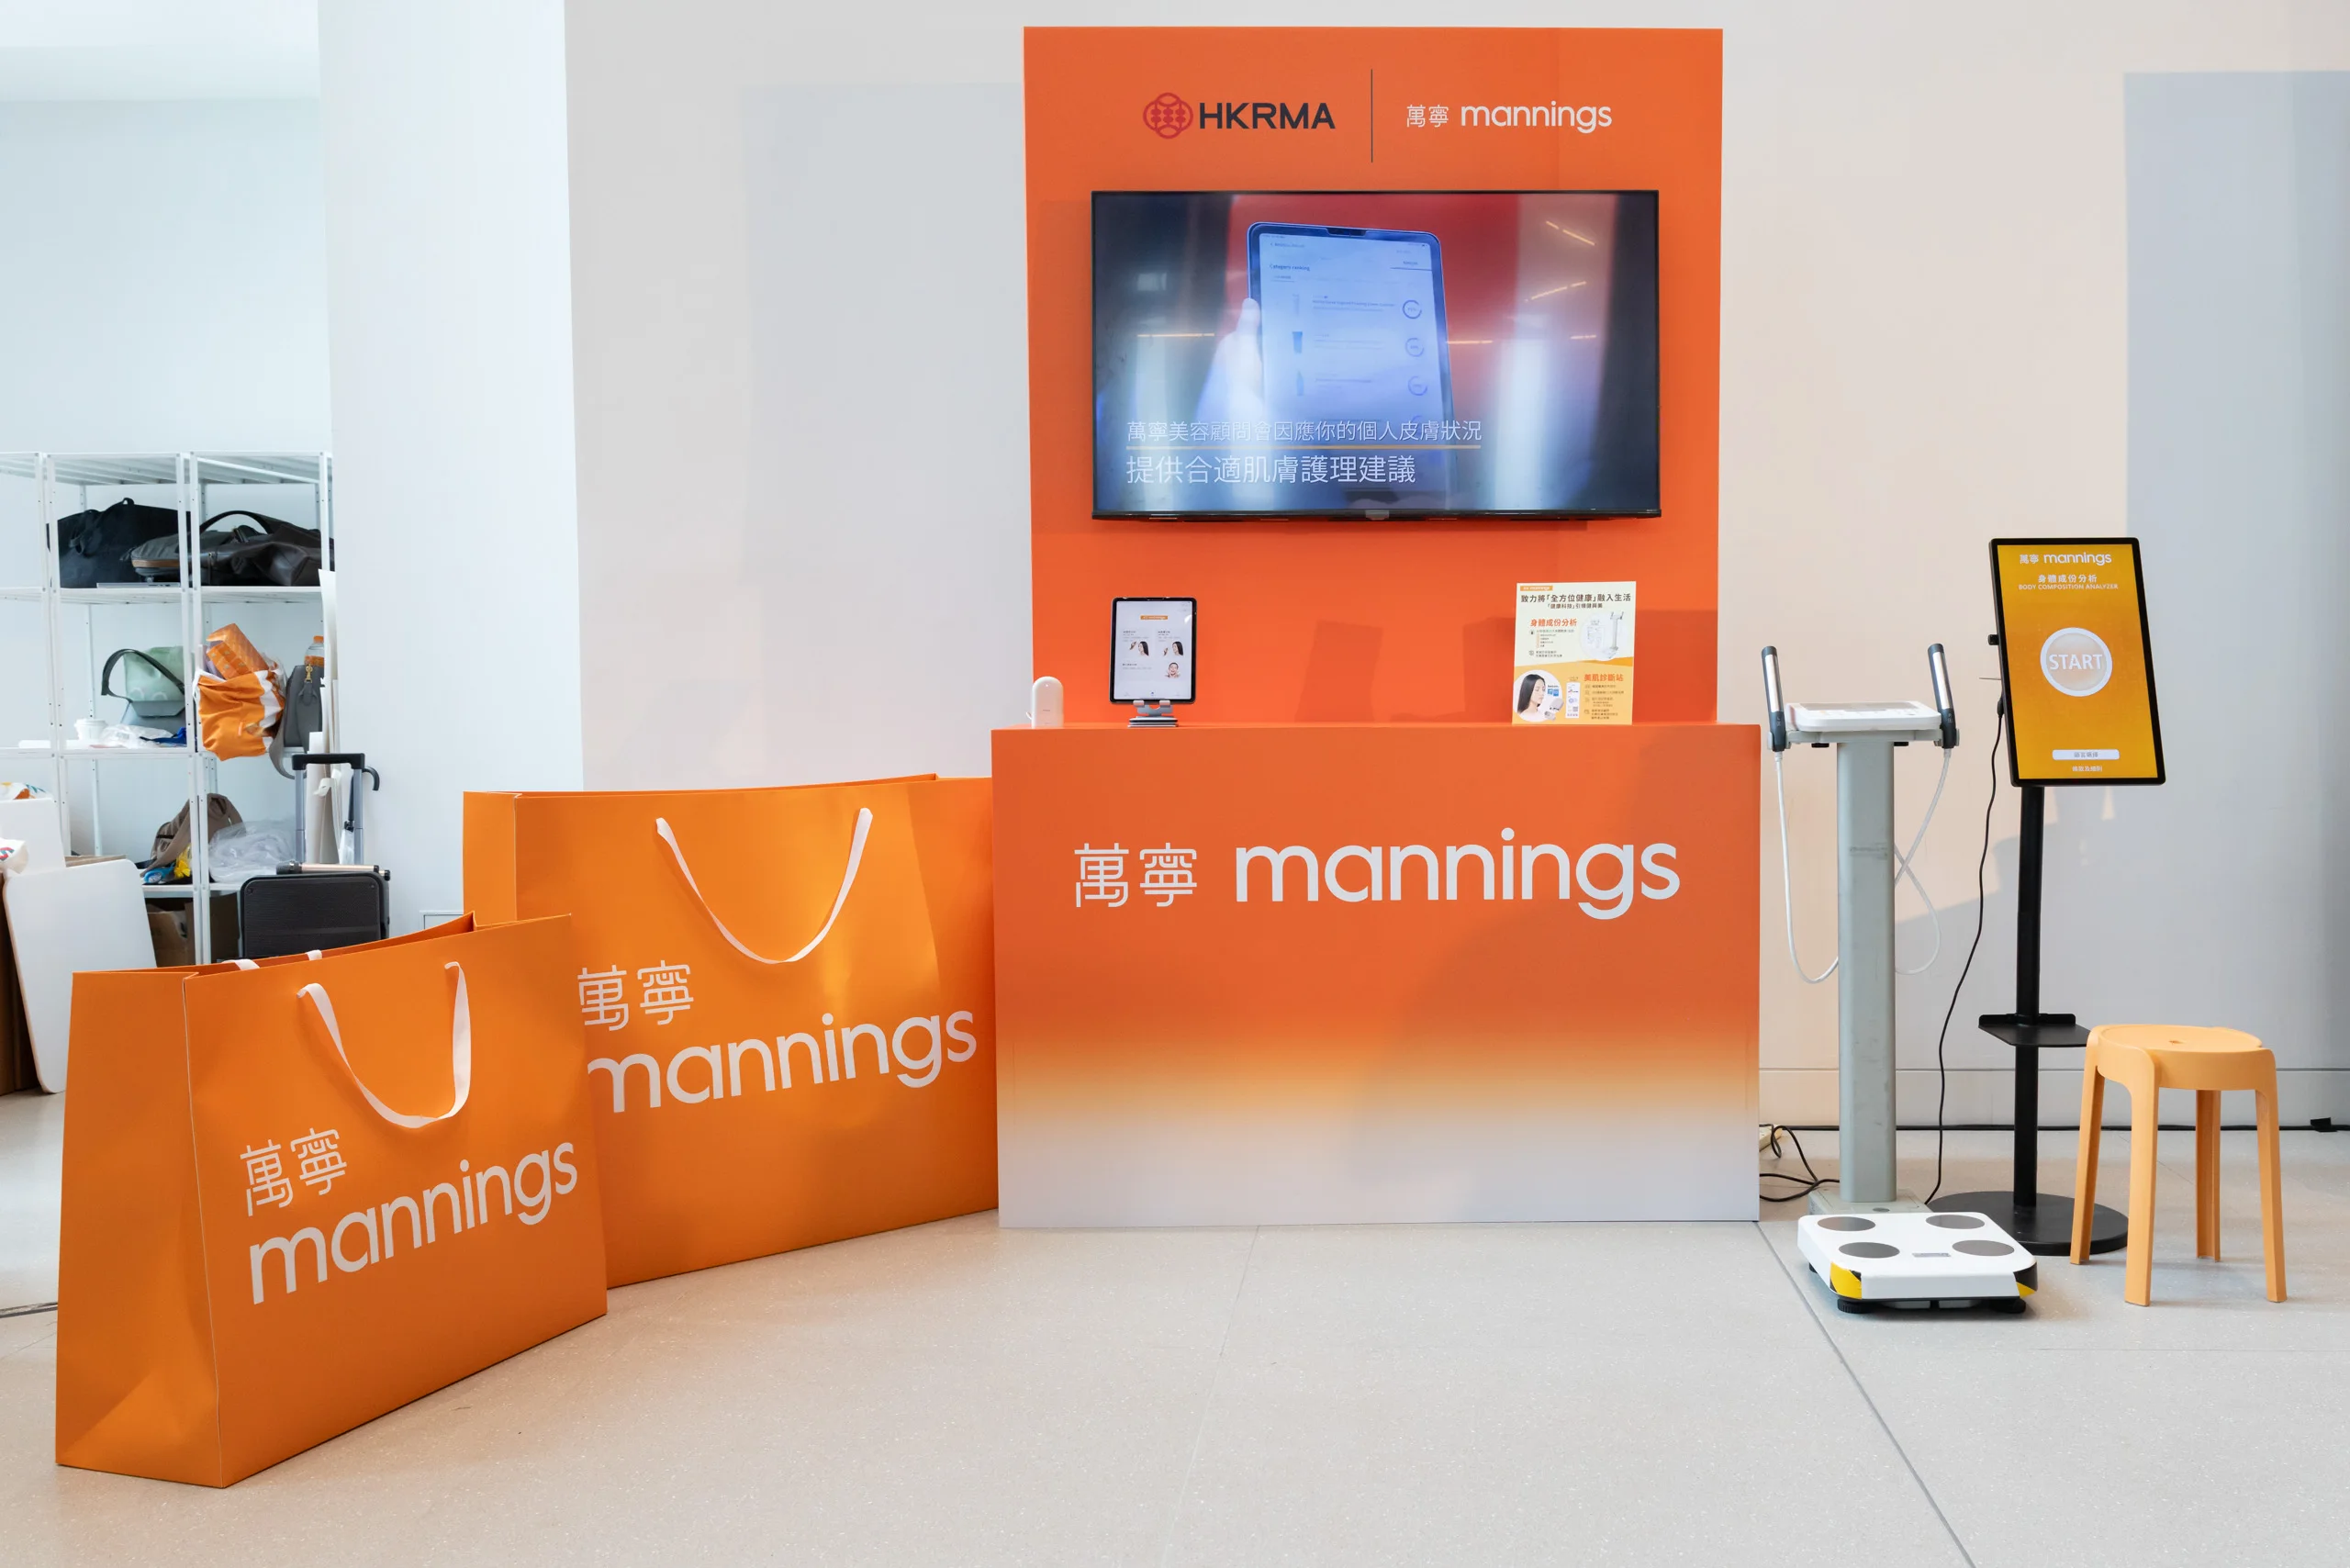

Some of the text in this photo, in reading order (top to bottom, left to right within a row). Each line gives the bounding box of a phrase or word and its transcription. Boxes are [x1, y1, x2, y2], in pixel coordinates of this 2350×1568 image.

[1200, 103, 1336, 129] HKRMA
[1406, 100, 1613, 134] 萬寧 mannings
[1126, 420, 1483, 442] 萬寧美容顧問會因應你的個人皮膚狀況
[1125, 454, 1416, 485] 提供合適肌膚護理建議
[2043, 552, 2112, 566] mannings
[2038, 574, 2098, 583] 身體成份分析
[1530, 618, 1577, 627] 身體成份分析
[2049, 654, 2103, 671] START
[1074, 827, 1681, 920] 萬寧 mannings
[577, 959, 694, 1031] 萬寧
[587, 1011, 978, 1114] mannings
[240, 1127, 347, 1217] 萬寧
[249, 1142, 578, 1305] mannings
